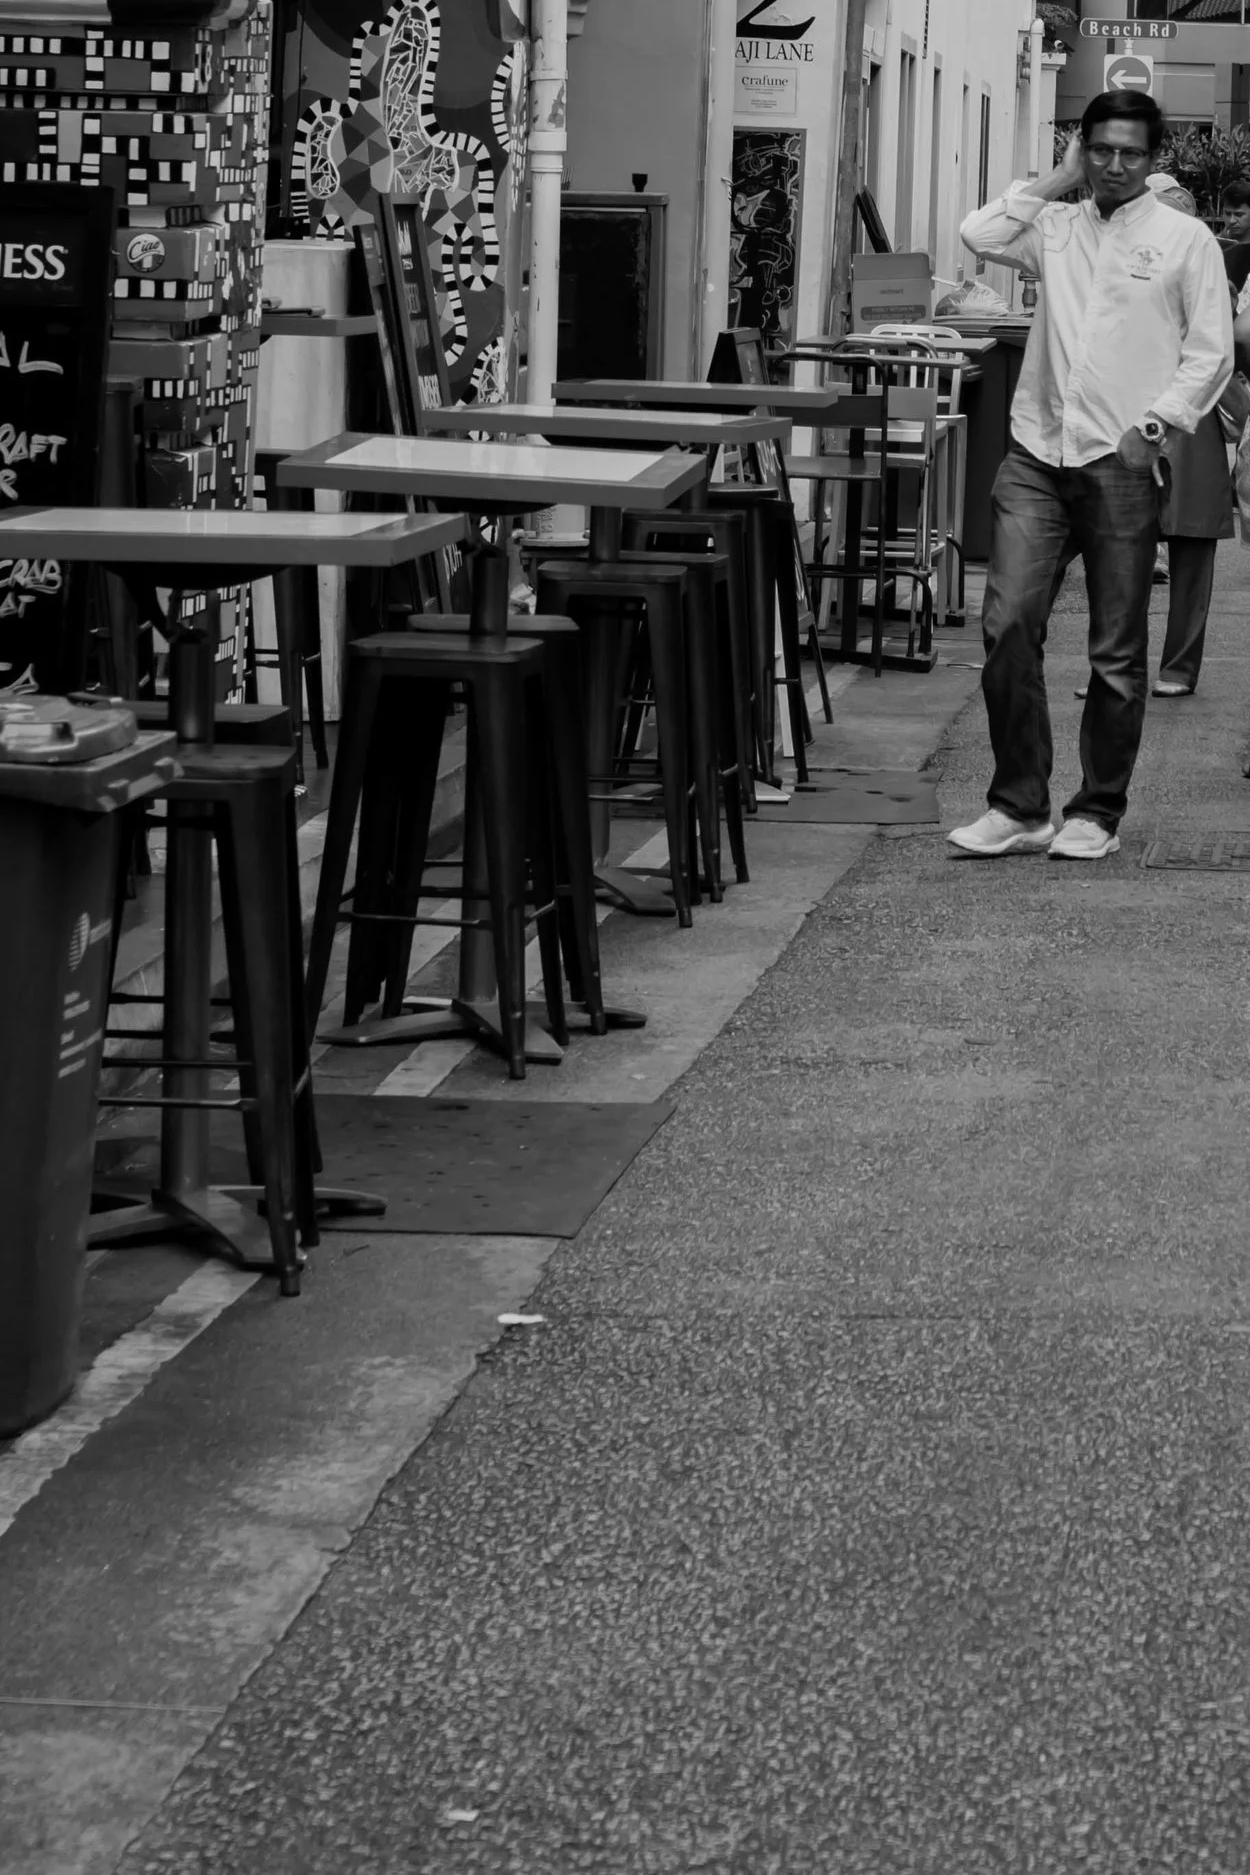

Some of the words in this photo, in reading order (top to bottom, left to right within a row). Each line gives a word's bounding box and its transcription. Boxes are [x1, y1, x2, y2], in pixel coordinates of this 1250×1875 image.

[1089, 21, 1142, 37] Beach
[1149, 22, 1170, 38] Rd
[766, 42, 814, 62] LANE
[0, 242, 66, 281] ESS
